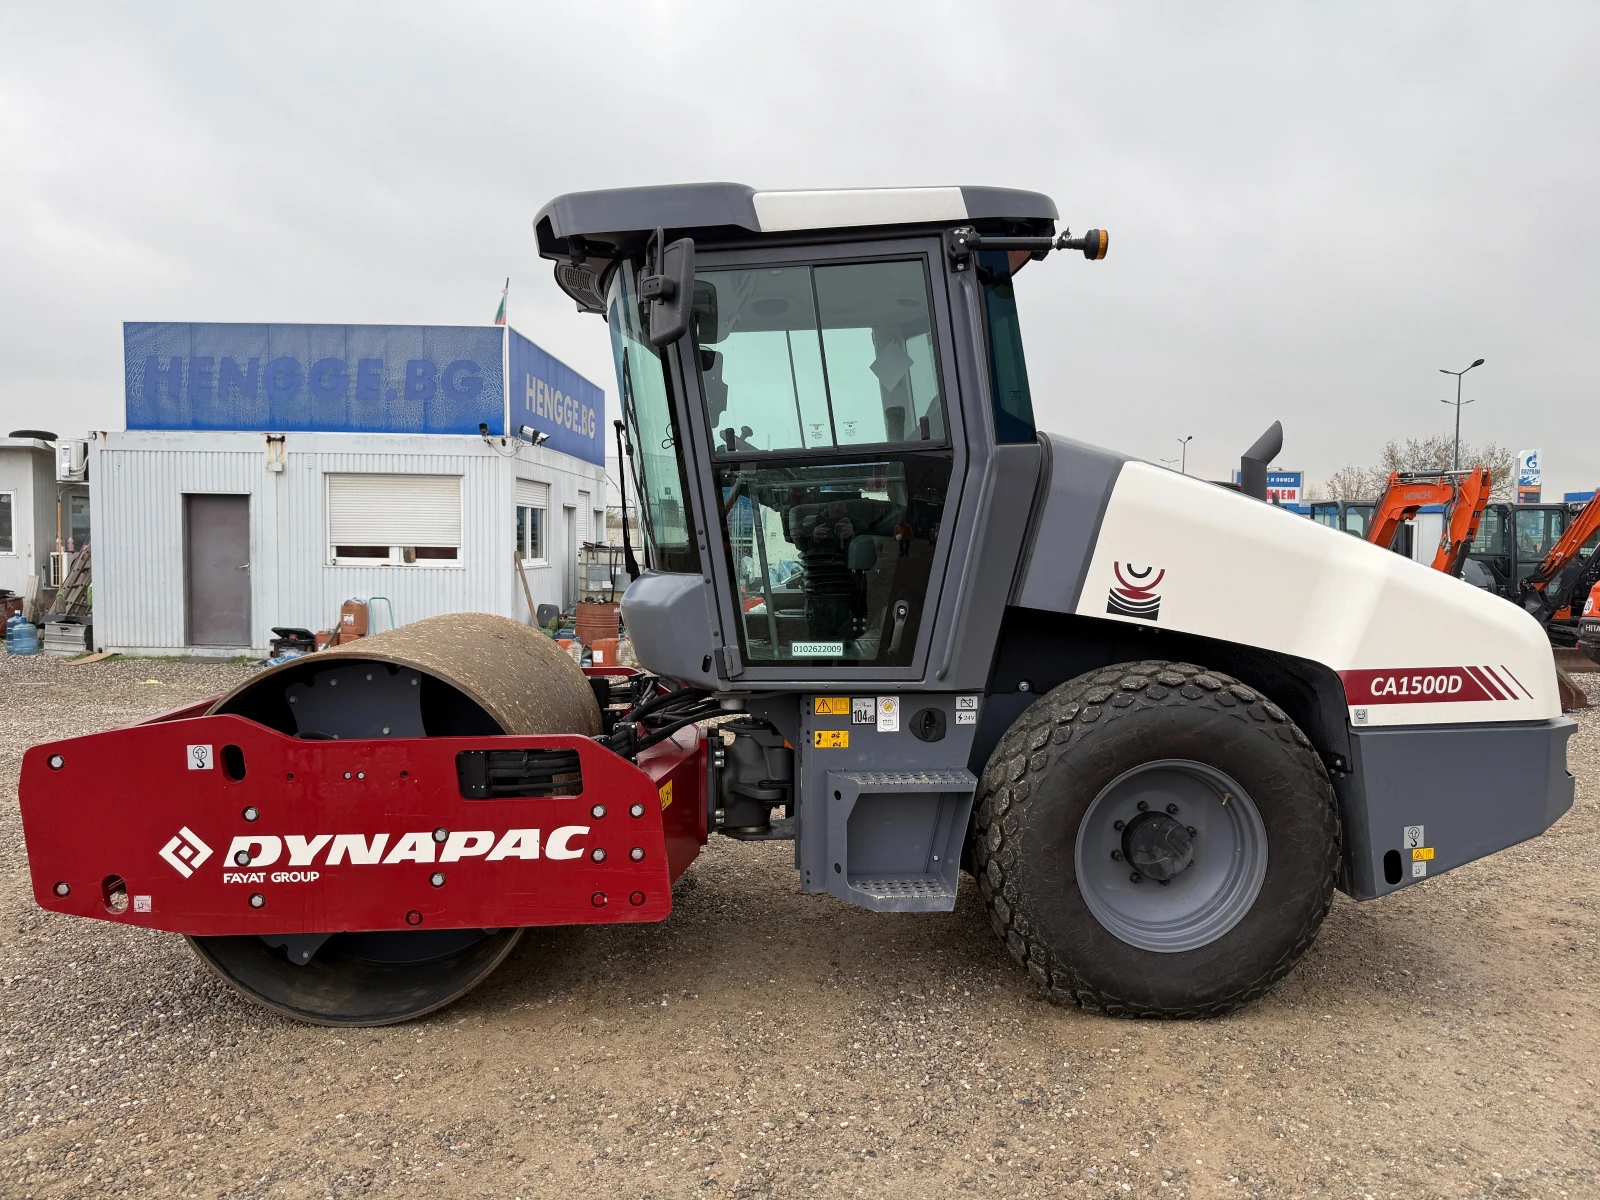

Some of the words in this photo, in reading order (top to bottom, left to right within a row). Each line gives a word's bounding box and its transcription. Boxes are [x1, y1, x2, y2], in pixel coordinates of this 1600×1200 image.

[144, 356, 484, 401] HENGGE.BG
[525, 372, 596, 439] HENGGE.BG
[1403, 491, 1433, 501] HITACHI
[793, 645, 842, 653] 0102622009
[1370, 675, 1463, 696] CA1500D
[853, 709, 867, 723] 104
[222, 825, 591, 868] DYNAPAC
[223, 872, 267, 884] FAYAT
[271, 871, 320, 883] GROUP
